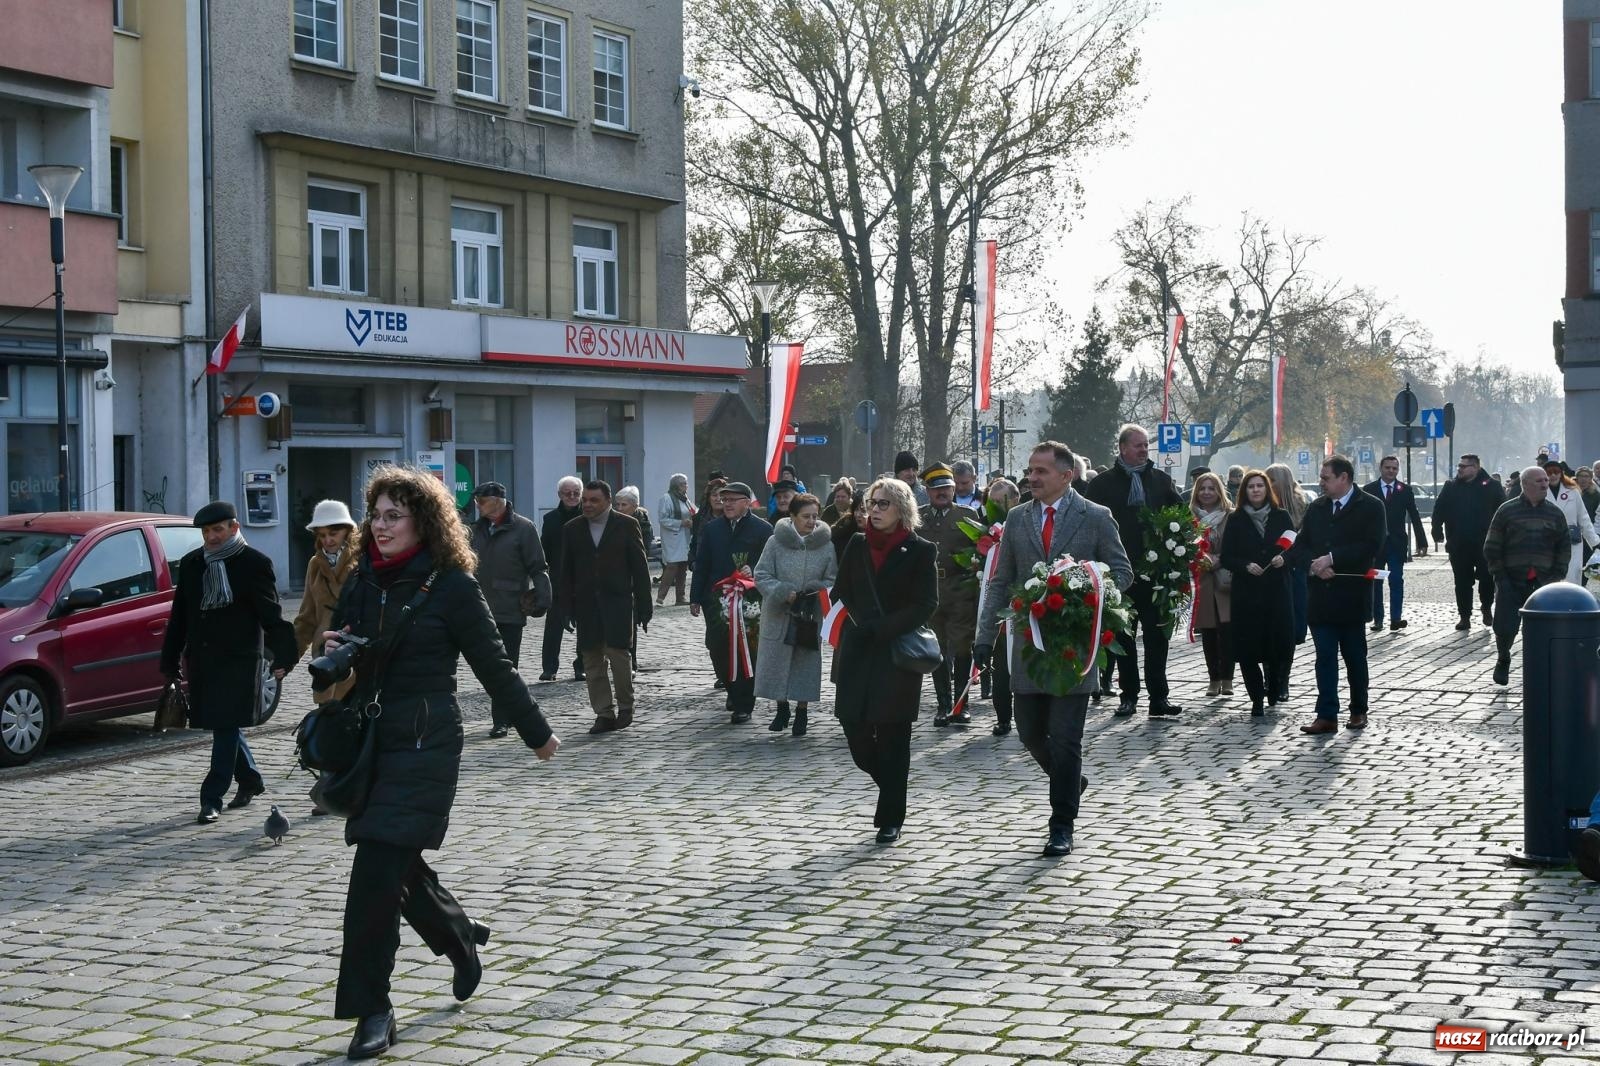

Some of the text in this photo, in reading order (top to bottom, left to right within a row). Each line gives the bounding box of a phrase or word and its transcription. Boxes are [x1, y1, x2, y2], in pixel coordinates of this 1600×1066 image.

[374, 311, 407, 331] TEB
[374, 334, 408, 343] EDUKACJA
[566, 325, 685, 360] ROSSMANN
[986, 427, 993, 437] P
[1163, 426, 1176, 444] P
[1194, 426, 1206, 442] P
[1362, 452, 1369, 461] P
